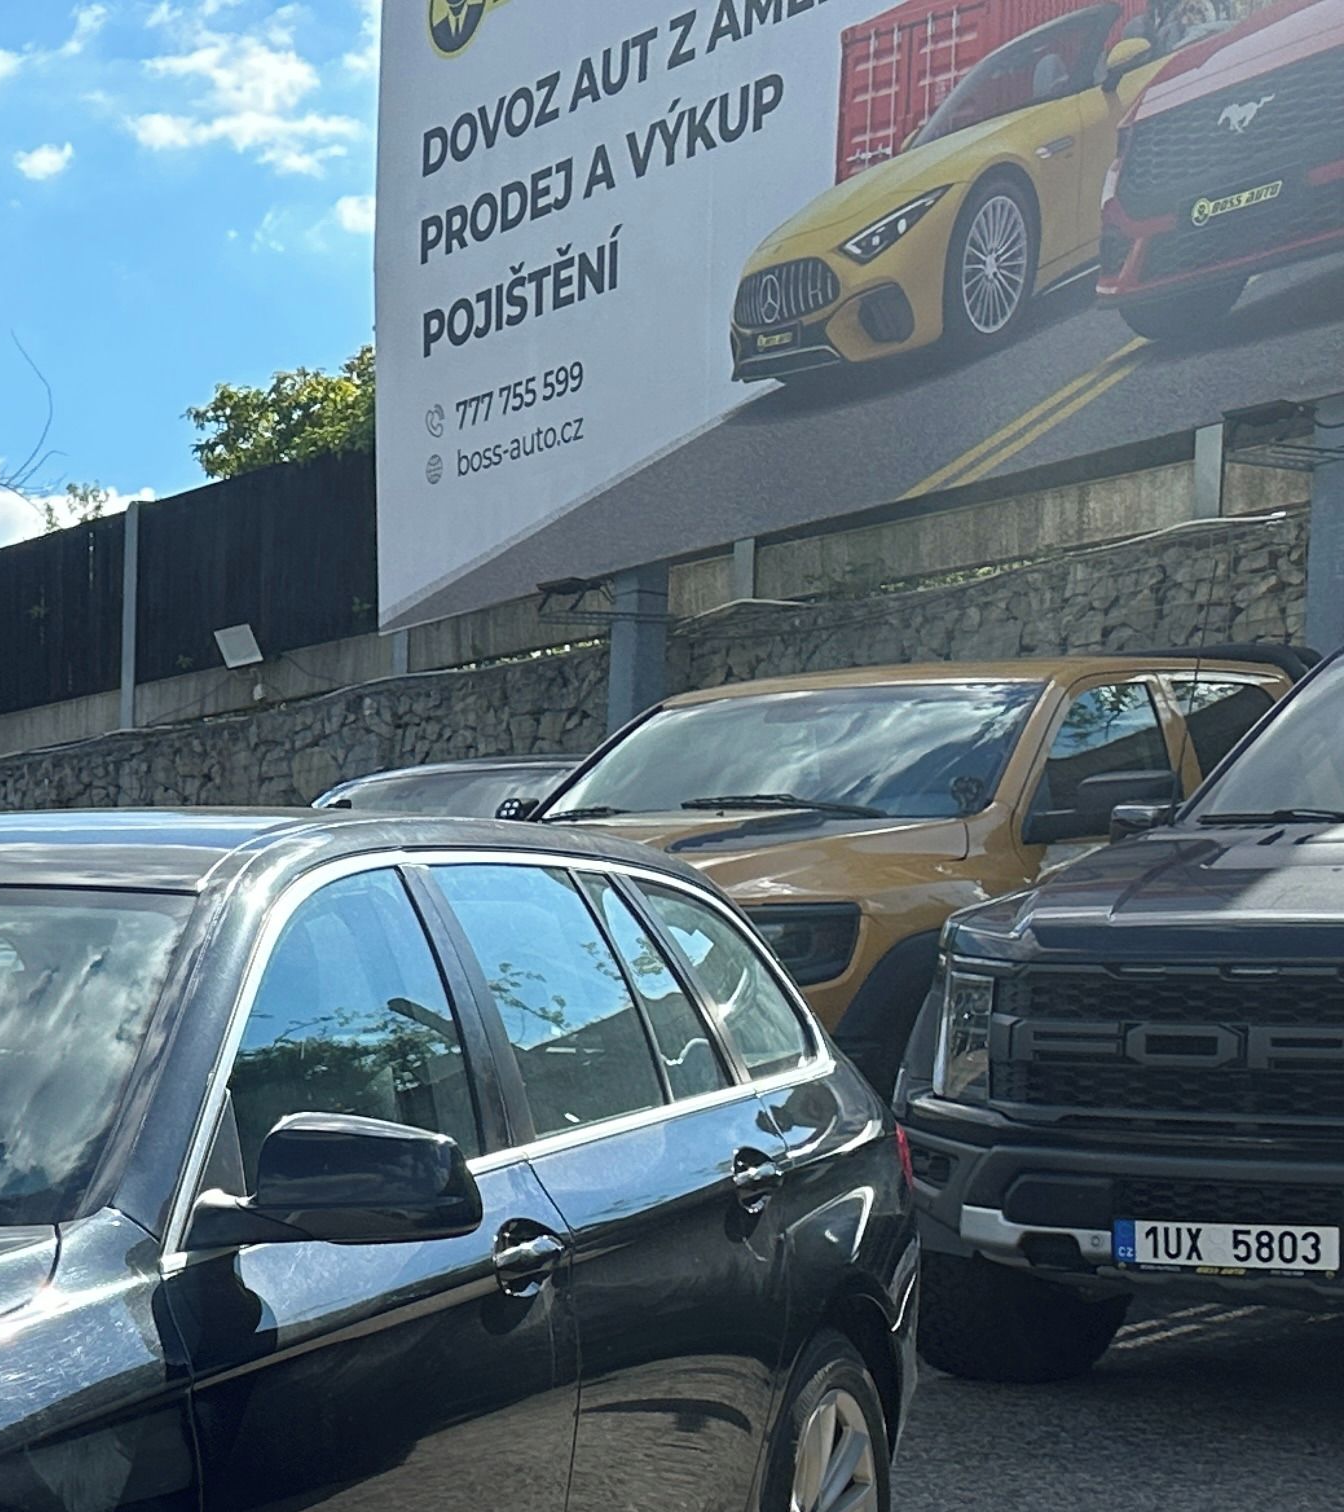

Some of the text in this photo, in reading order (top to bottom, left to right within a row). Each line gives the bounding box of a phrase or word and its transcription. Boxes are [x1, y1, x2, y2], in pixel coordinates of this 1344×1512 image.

[421, 70, 561, 178] DOVOZ
[568, 26, 659, 113] AUT
[666, 8, 698, 71] Z
[420, 73, 785, 265] PRODEJ A VÝKUP
[1245, 183, 1280, 203] AUTO
[422, 223, 624, 359] POJIŠTĚNÍ
[455, 360, 584, 431] 777 755 599
[457, 417, 585, 477] boss-auto.cz
[1118, 1246, 1134, 1258] CZ
[1144, 1225, 1322, 1265] 1UX 5803
